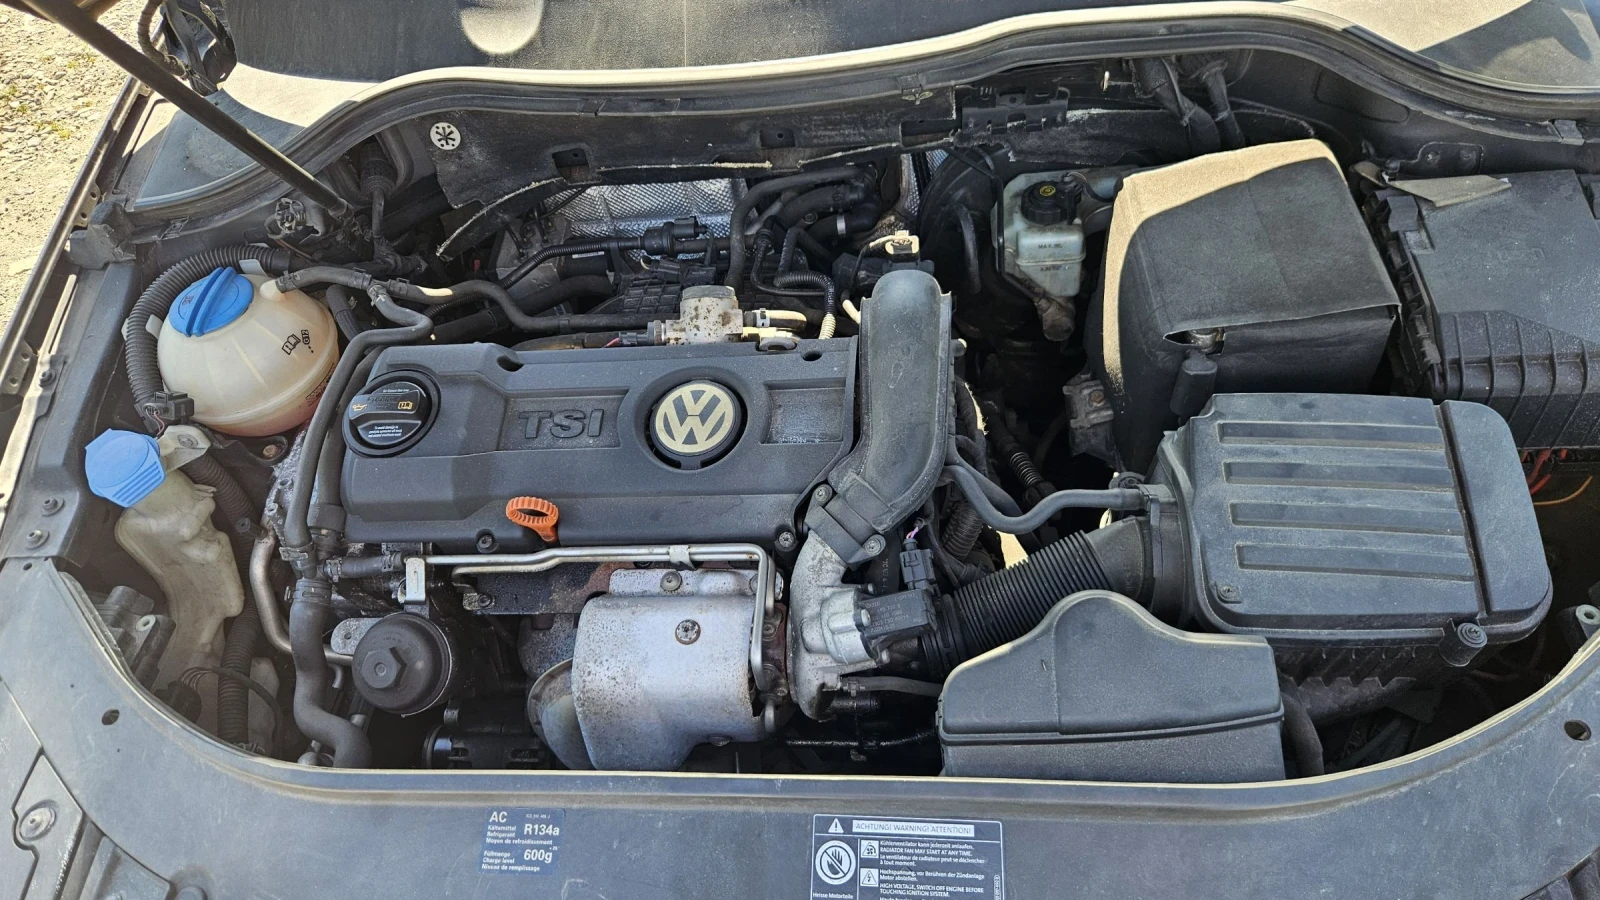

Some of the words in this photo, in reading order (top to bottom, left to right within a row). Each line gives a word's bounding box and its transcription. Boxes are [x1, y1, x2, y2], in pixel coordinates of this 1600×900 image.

[518, 408, 605, 440] TSI
[489, 811, 507, 823] AC
[523, 823, 560, 836] R134a
[855, 822, 892, 831] ACHTUNG!
[893, 824, 930, 832] WARNING!
[930, 826, 972, 834] ATTENTION!
[483, 850, 511, 858] Füllmenge
[523, 849, 553, 864] 600g
